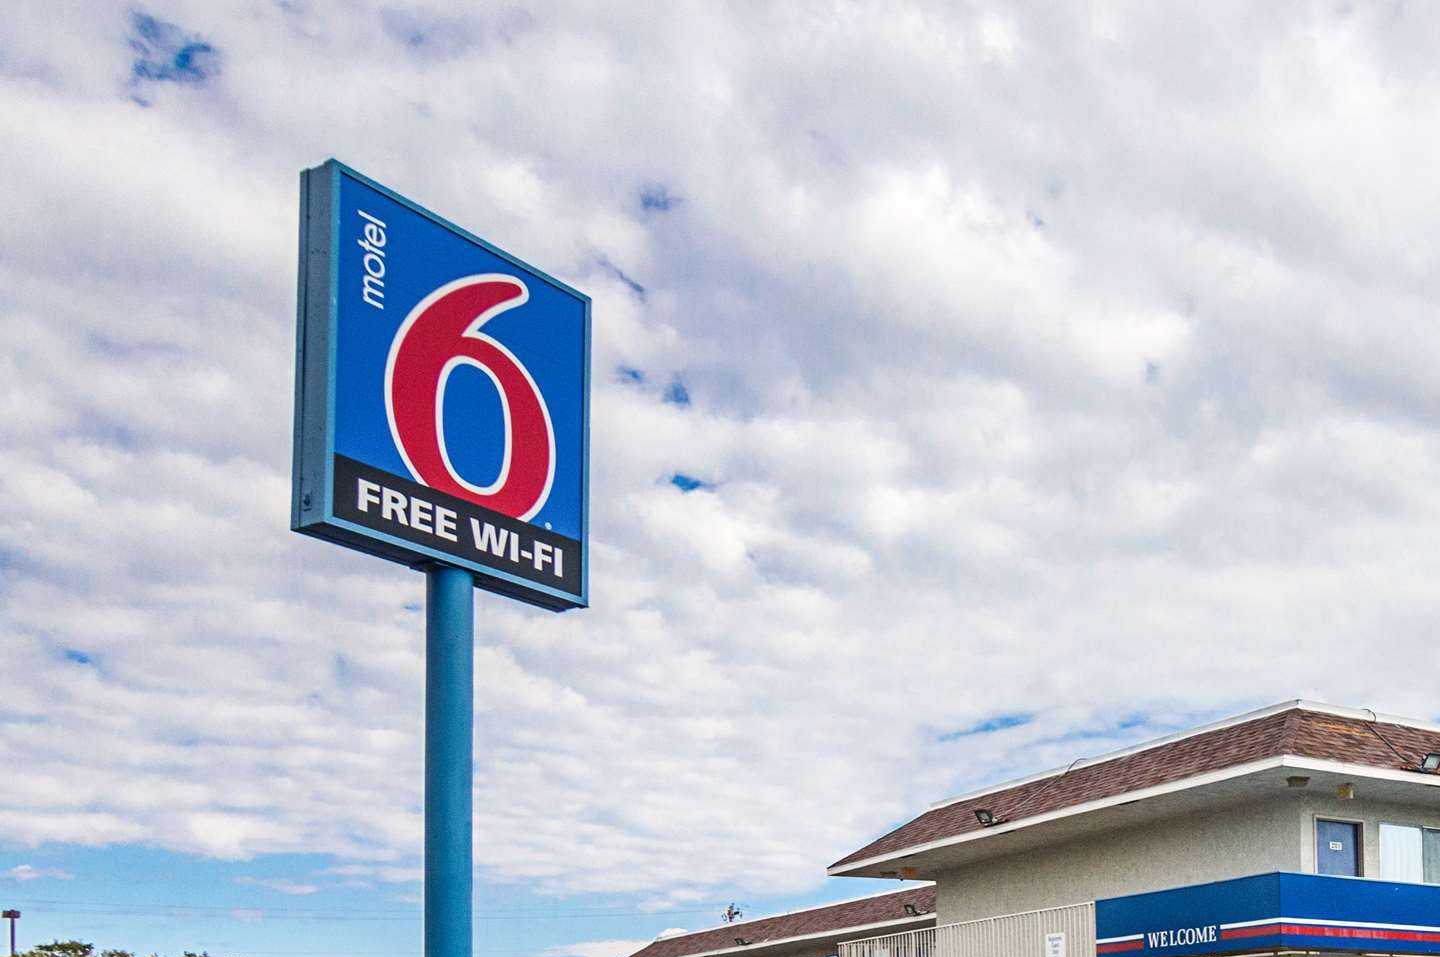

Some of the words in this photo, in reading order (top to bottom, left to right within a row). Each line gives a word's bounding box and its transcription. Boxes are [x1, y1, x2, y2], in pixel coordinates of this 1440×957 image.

[357, 210, 386, 309] motel
[384, 273, 556, 523] 6
[357, 478, 458, 541] FREE
[470, 517, 563, 577] WI-FI
[1147, 925, 1217, 948] WELCOME
